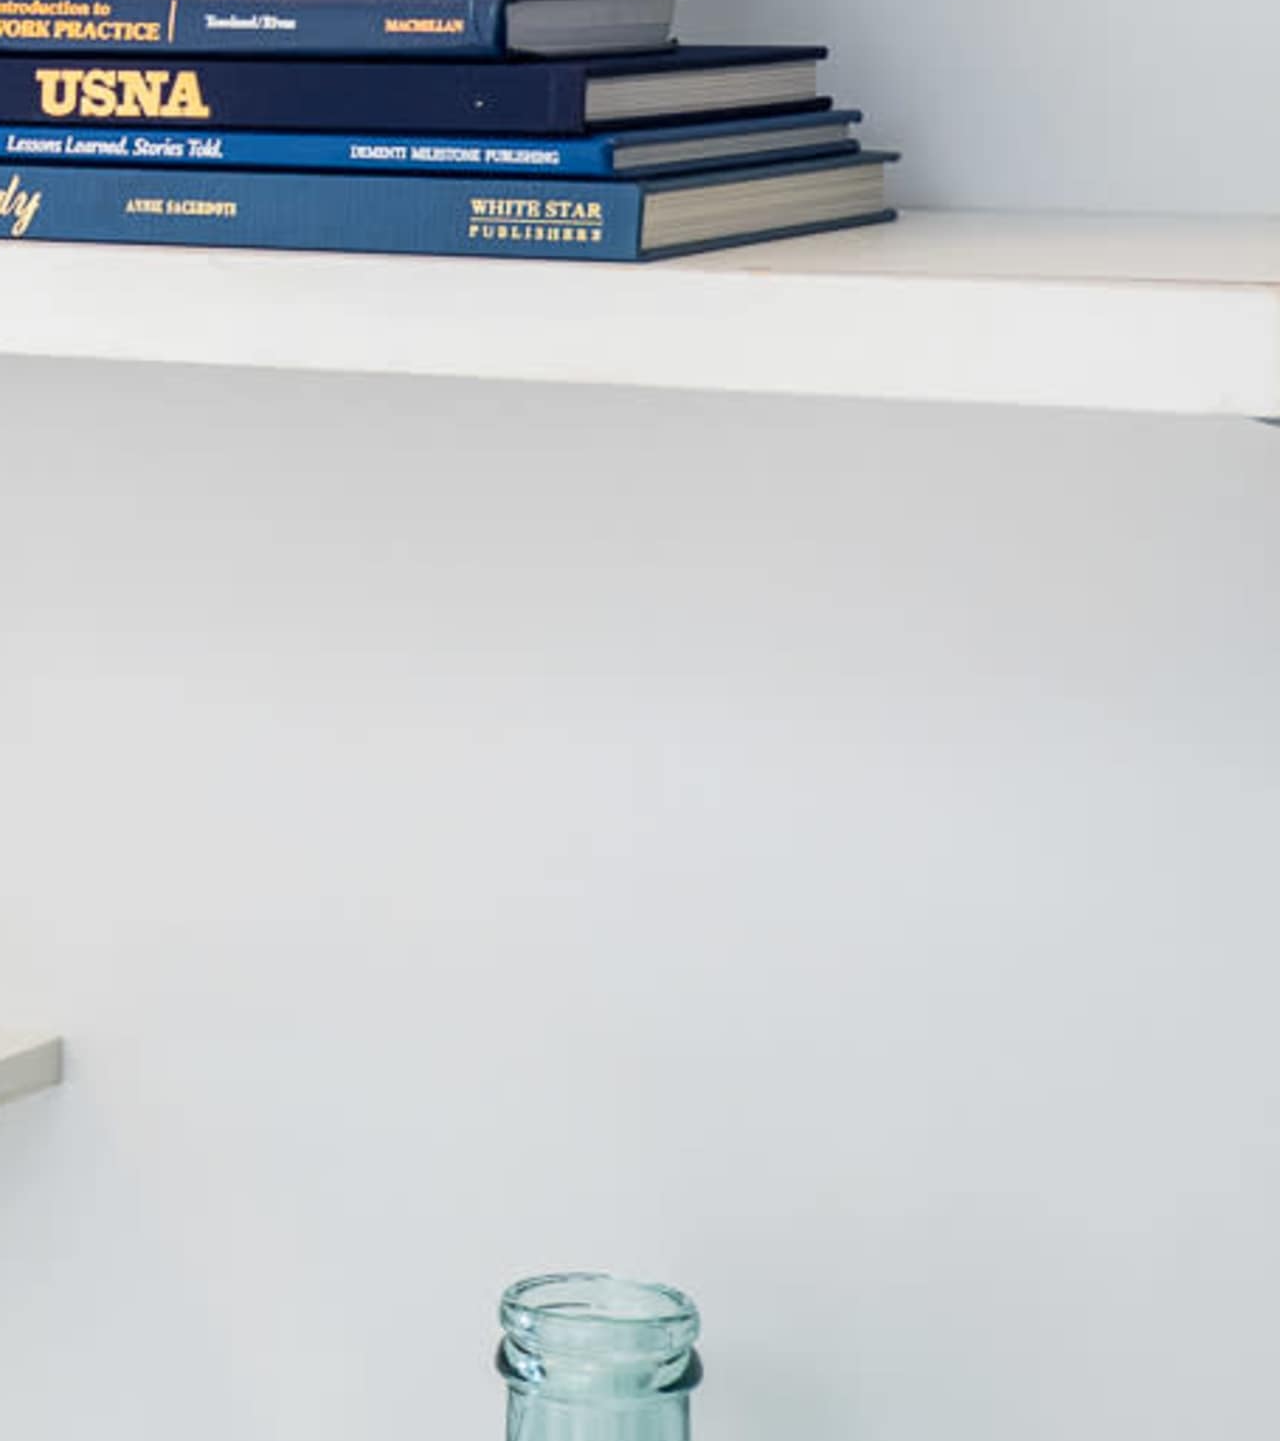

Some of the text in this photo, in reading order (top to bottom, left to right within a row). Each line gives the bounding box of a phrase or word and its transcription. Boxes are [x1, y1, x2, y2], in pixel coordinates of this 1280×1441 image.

[93, 0, 112, 17] to
[53, 19, 162, 42] PRACTICE
[35, 68, 212, 119] USNA
[5, 134, 63, 154] Lessons
[63, 135, 131, 157] Learned.
[131, 136, 186, 158] Stories
[187, 138, 224, 160] Told.
[484, 146, 561, 166] PUBLISHING
[468, 196, 604, 221] WHITE STAR
[468, 222, 604, 243] PUBLISHERS
